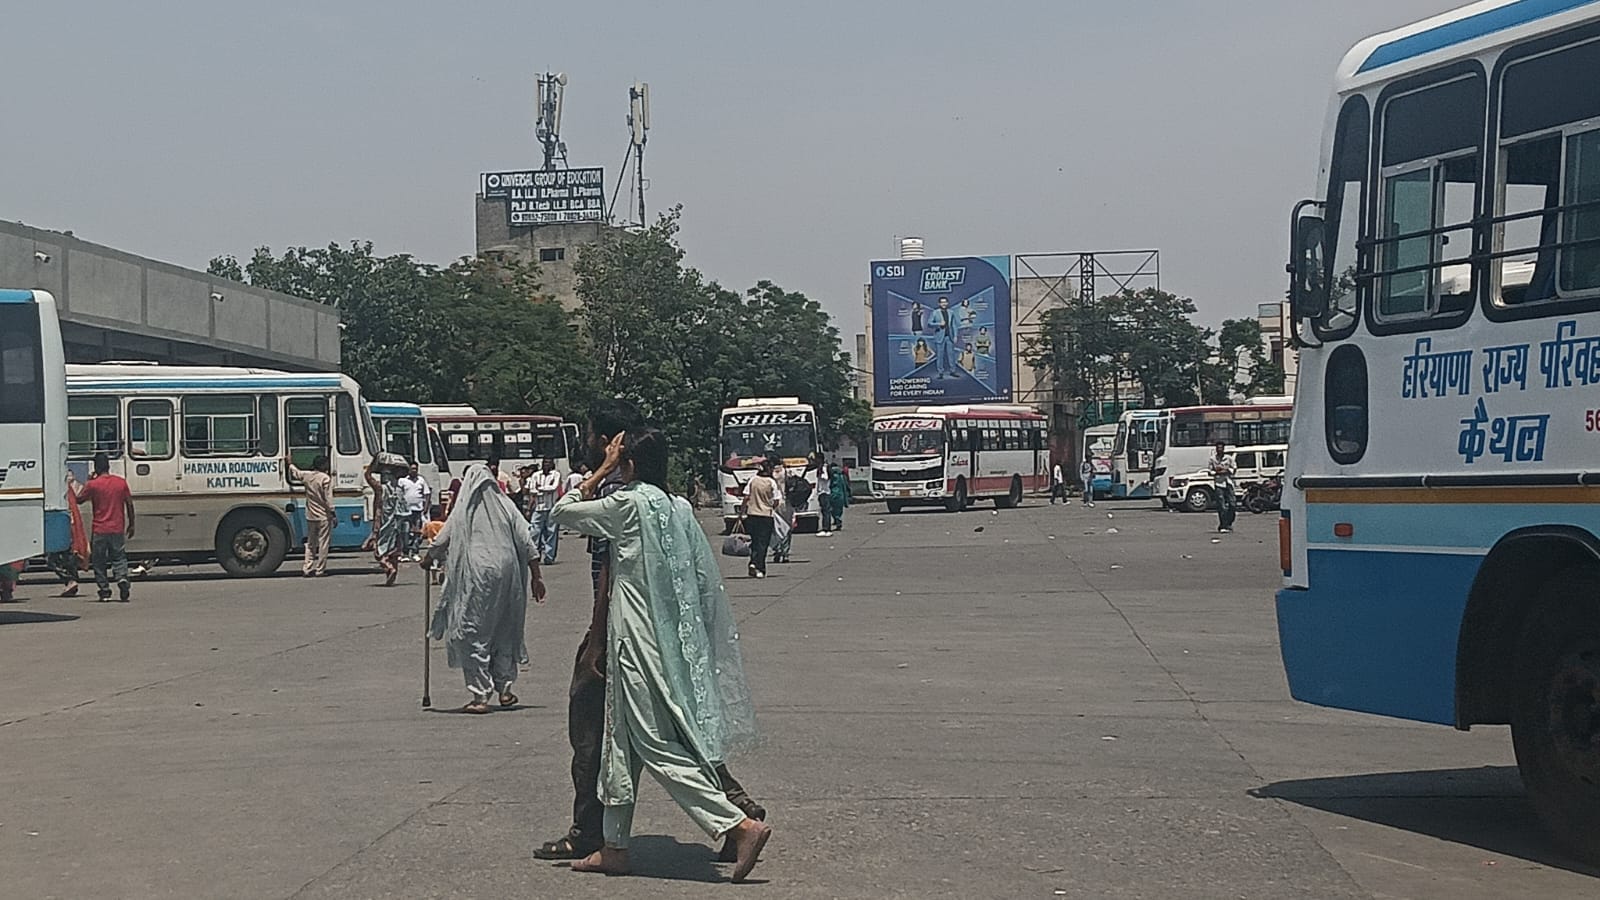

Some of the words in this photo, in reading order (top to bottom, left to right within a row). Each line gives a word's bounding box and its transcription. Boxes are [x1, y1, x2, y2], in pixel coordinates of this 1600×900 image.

[501, 174, 533, 187] UNIVERSAL
[535, 173, 556, 187] GROUP
[557, 171, 566, 185] OF
[567, 170, 601, 184] EDUCATION
[887, 265, 905, 277] SBI
[925, 271, 961, 281] COOLEST
[924, 280, 948, 290] BANK
[1402, 337, 1473, 398] हरियाणा
[1482, 343, 1530, 393] राज्य
[890, 377, 931, 385] EMPOWERING
[728, 413, 807, 425] SHIRA
[878, 419, 937, 429] SHIRA
[1458, 397, 1550, 464] कैथल
[8, 461, 36, 471] PRO
[184, 462, 227, 474] HARYANA
[229, 461, 278, 473] ROADWAYS
[207, 476, 260, 488] KAITHAL
